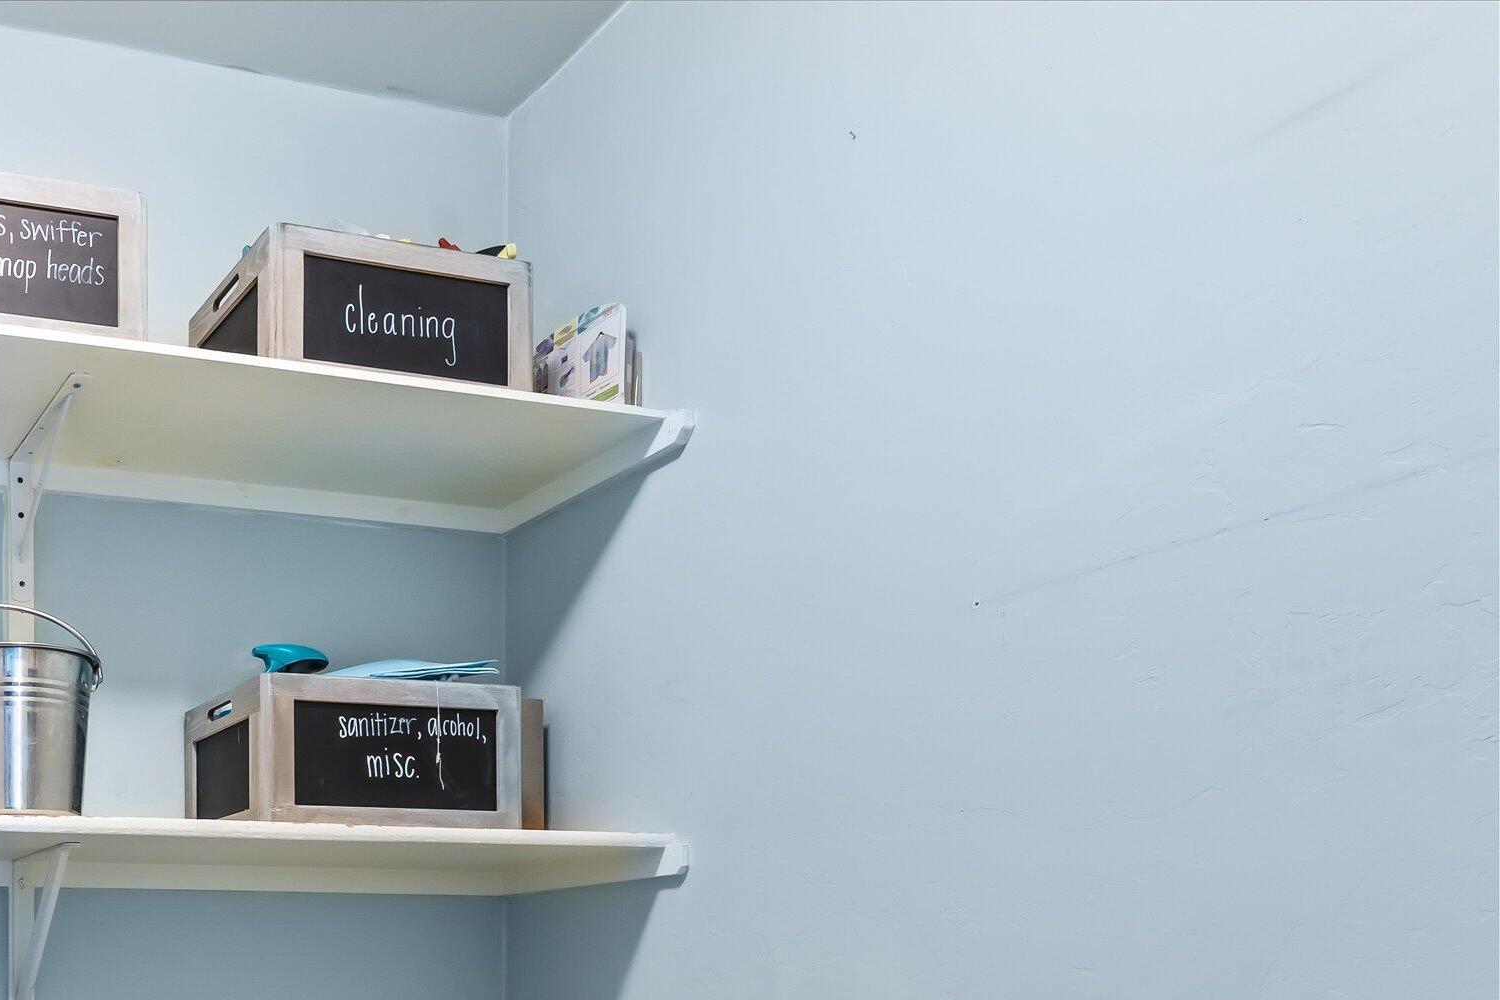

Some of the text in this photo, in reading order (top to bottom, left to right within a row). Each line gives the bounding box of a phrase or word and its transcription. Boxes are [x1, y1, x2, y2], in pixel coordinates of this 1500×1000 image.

[19, 218, 103, 248] swiffer
[46, 248, 105, 286] heads
[345, 284, 456, 366] cleaning
[338, 712, 487, 744] sanitizer, alcohol,
[366, 747, 420, 778] misc.
